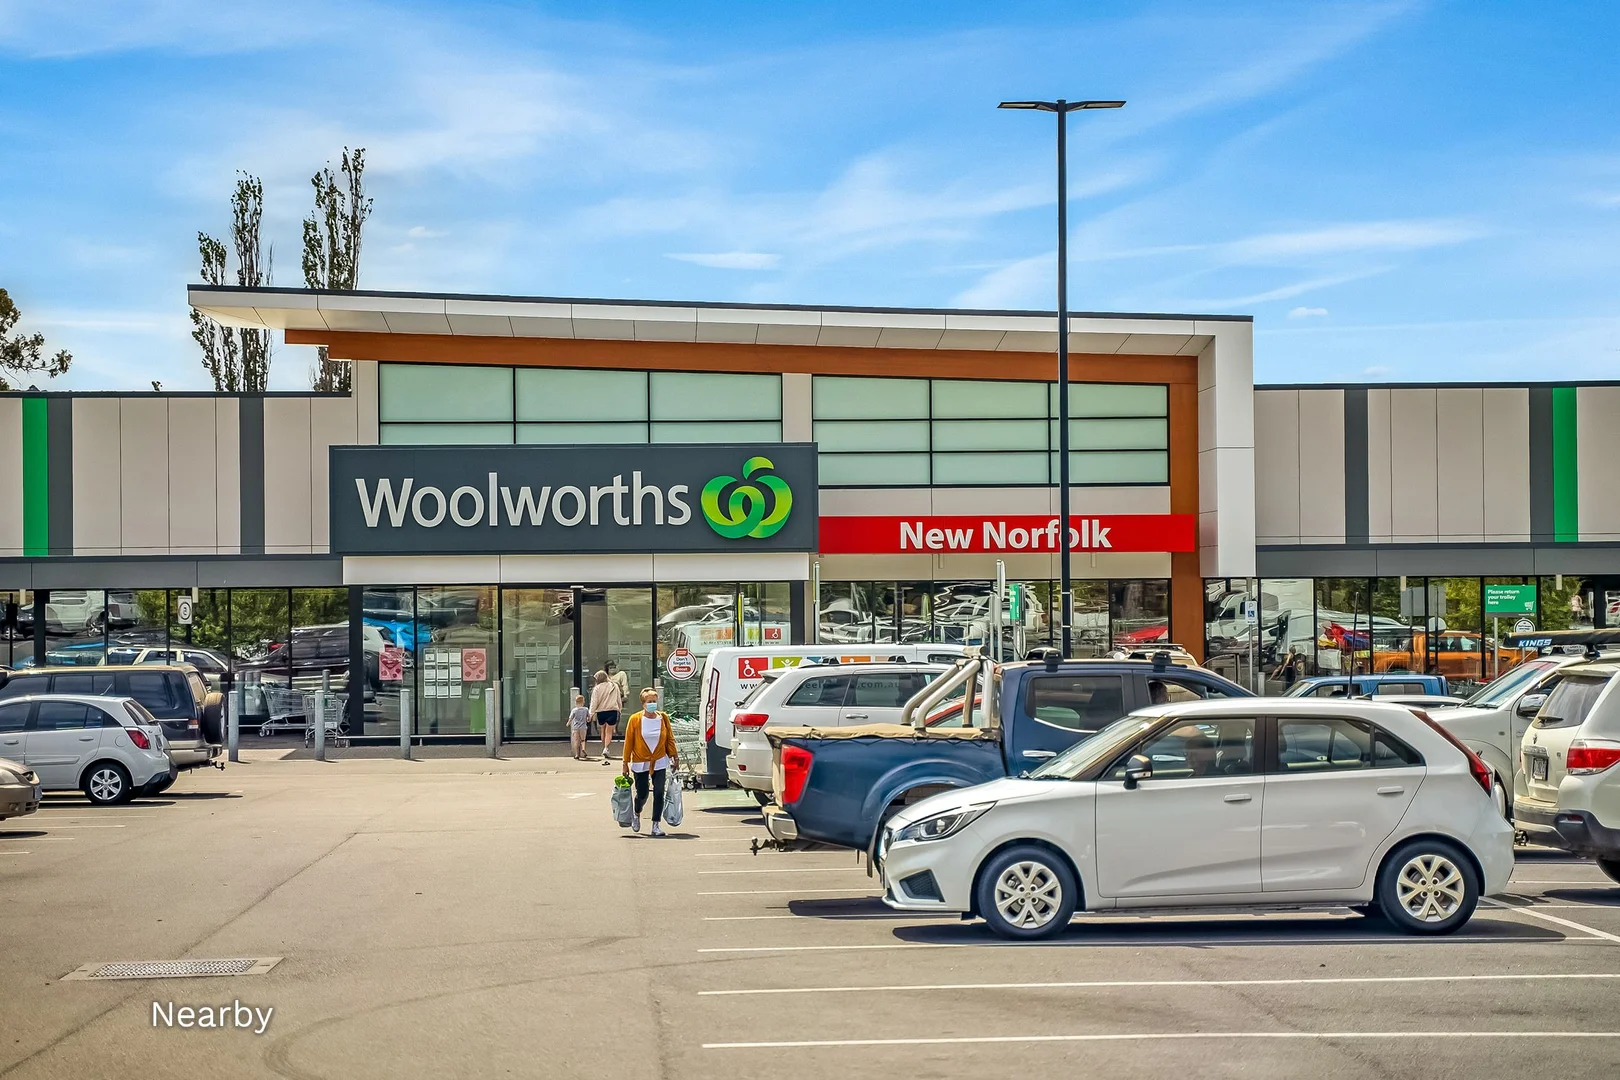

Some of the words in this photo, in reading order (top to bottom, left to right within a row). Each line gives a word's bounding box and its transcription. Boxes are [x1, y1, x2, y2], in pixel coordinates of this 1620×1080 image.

[355, 471, 692, 527] Woolworths
[900, 521, 974, 549] New
[983, 519, 1112, 549] Norfolk
[1518, 638, 1552, 647] KINGS
